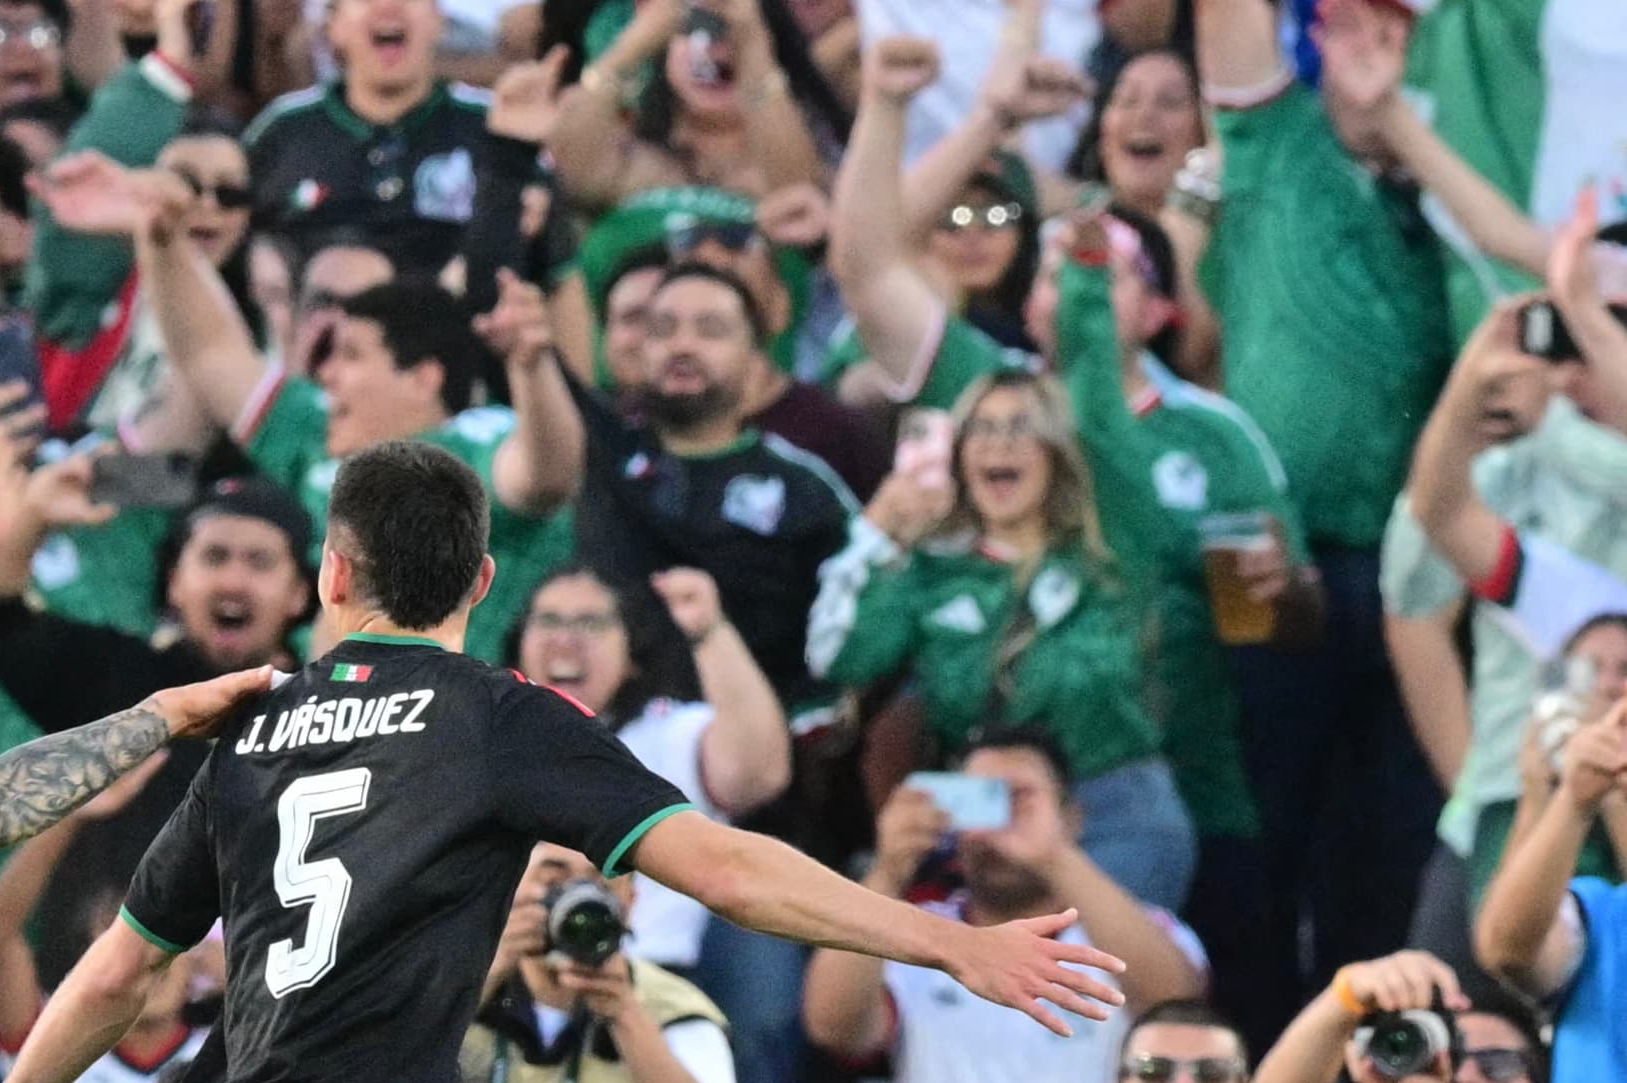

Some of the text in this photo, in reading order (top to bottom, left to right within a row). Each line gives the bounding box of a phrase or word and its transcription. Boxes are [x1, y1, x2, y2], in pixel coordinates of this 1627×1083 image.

[235, 688, 435, 755] J. VÁSQUEZ
[265, 767, 372, 999] 5
